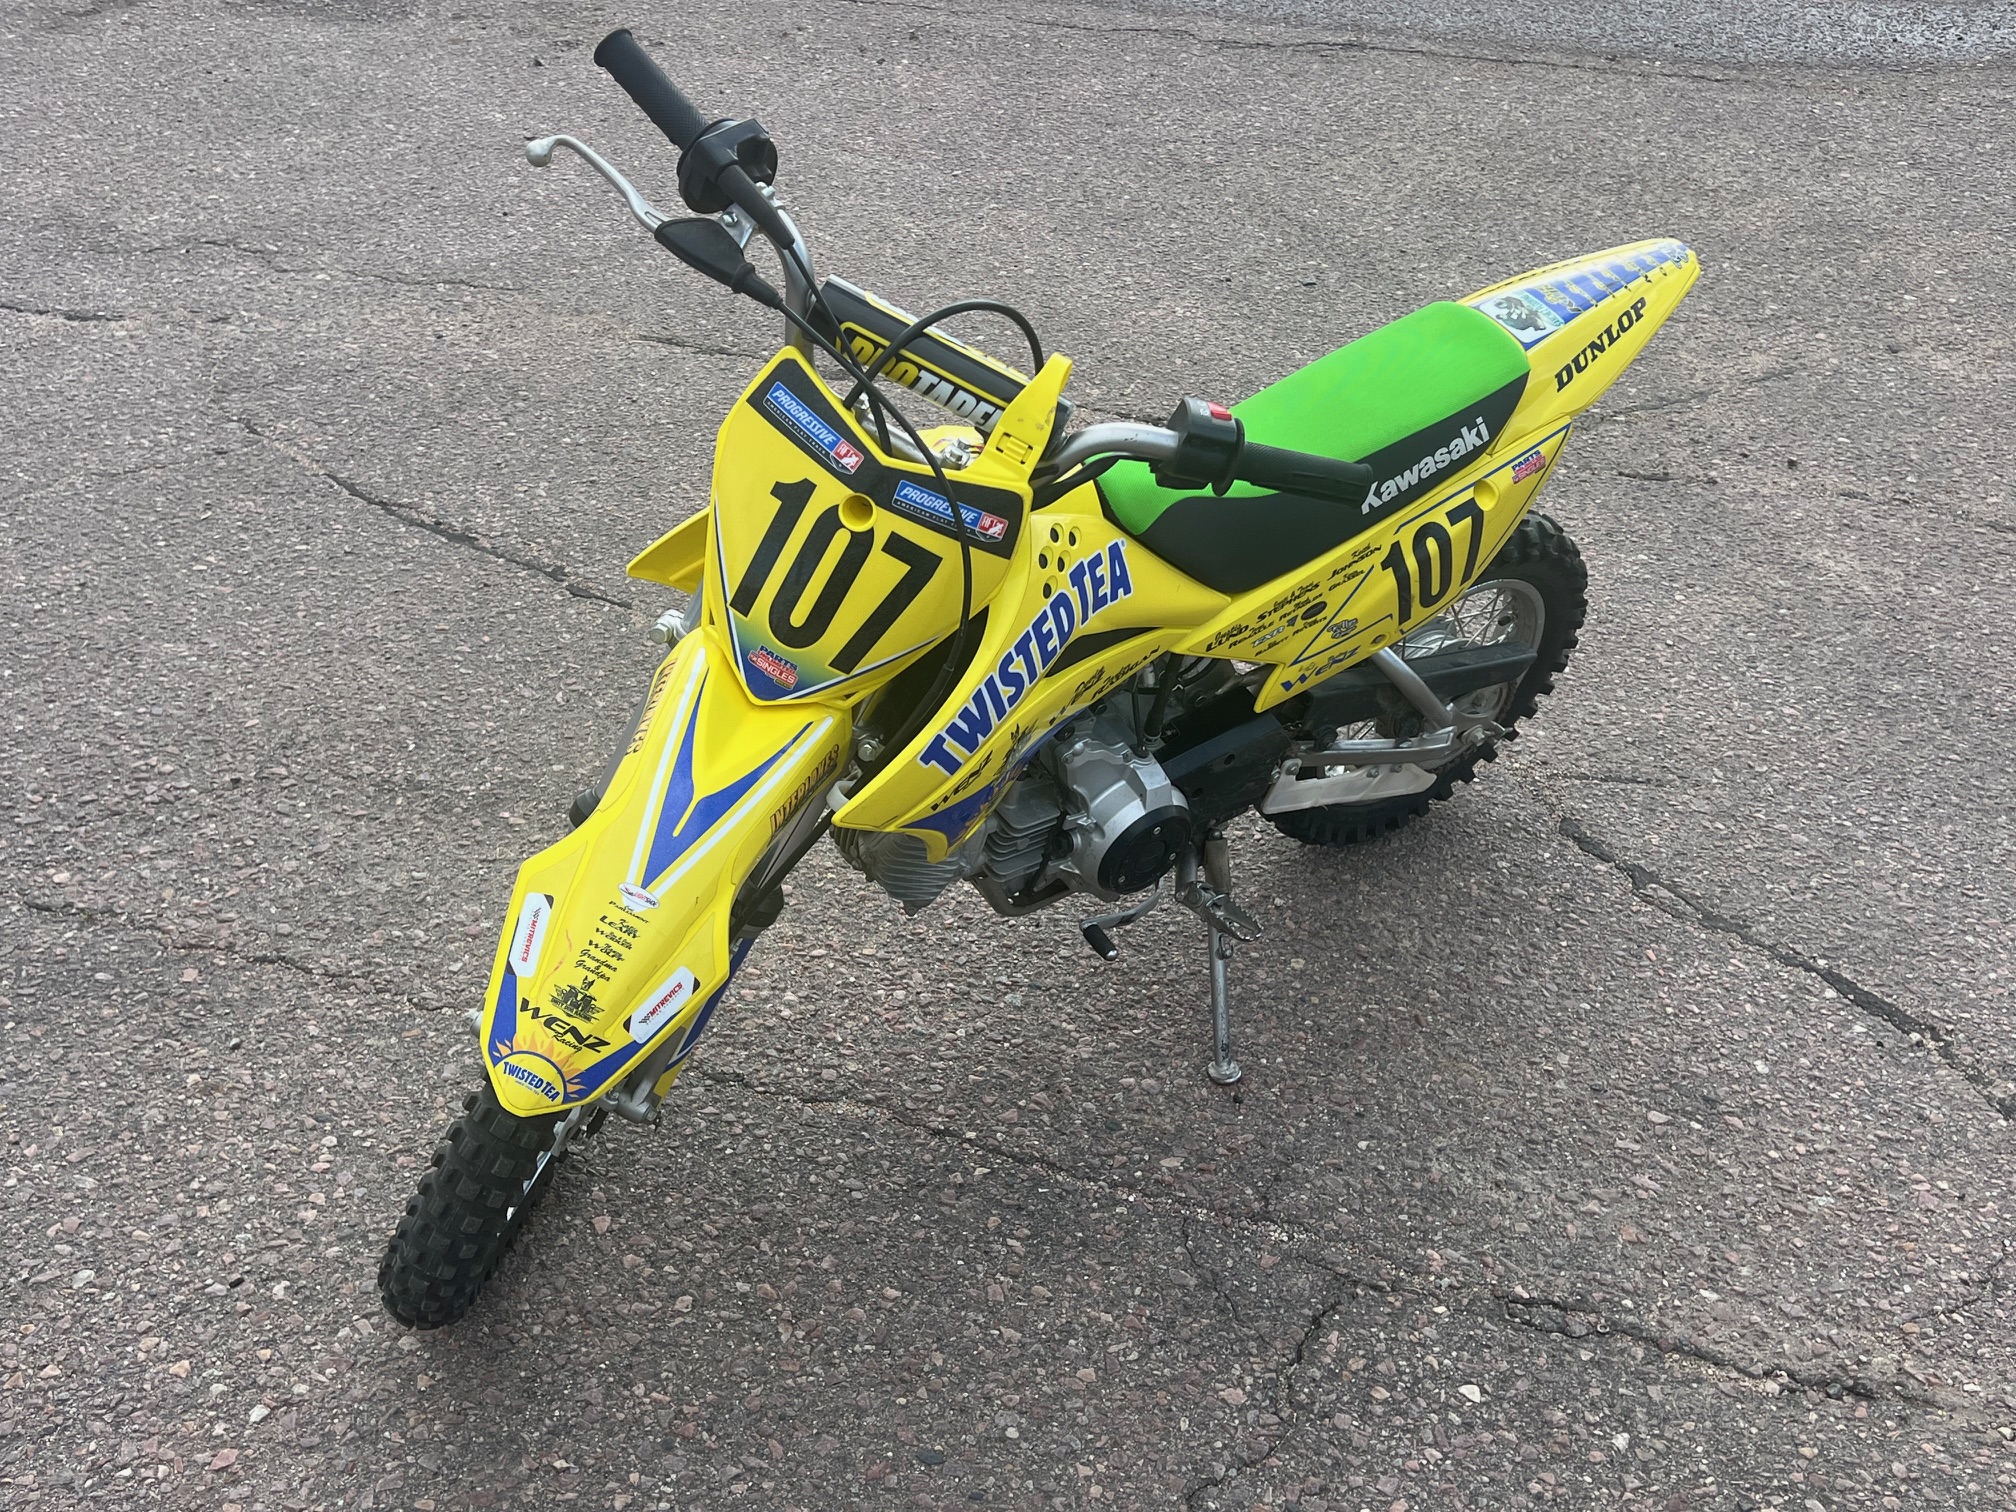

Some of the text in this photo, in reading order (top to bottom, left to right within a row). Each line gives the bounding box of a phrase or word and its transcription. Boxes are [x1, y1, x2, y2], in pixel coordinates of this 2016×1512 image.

[1554, 296, 1648, 393] DUNLOP
[772, 387, 836, 445] PROGRESSIVE
[1360, 416, 1491, 516] Kawasaki
[1511, 449, 1540, 470] PARTS
[729, 477, 943, 675] 107
[1327, 545, 1381, 581] JOHNSON
[1380, 496, 1485, 627] 107
[1205, 624, 1249, 652] LUND
[755, 657, 795, 683] SINGLES
[759, 645, 798, 670] PARTS
[918, 592, 1076, 777] TWISTED
[1069, 541, 1132, 624] TEA
[521, 919, 537, 962] MITREVICS
[574, 959, 611, 983] Grandpa
[580, 948, 618, 973] Grandma
[648, 981, 682, 1017] MITREVICS
[519, 997, 611, 1054] WENZ
[551, 1032, 583, 1054] Racing
[503, 1061, 543, 1089] TWISTED
[541, 1081, 560, 1102] TEA
